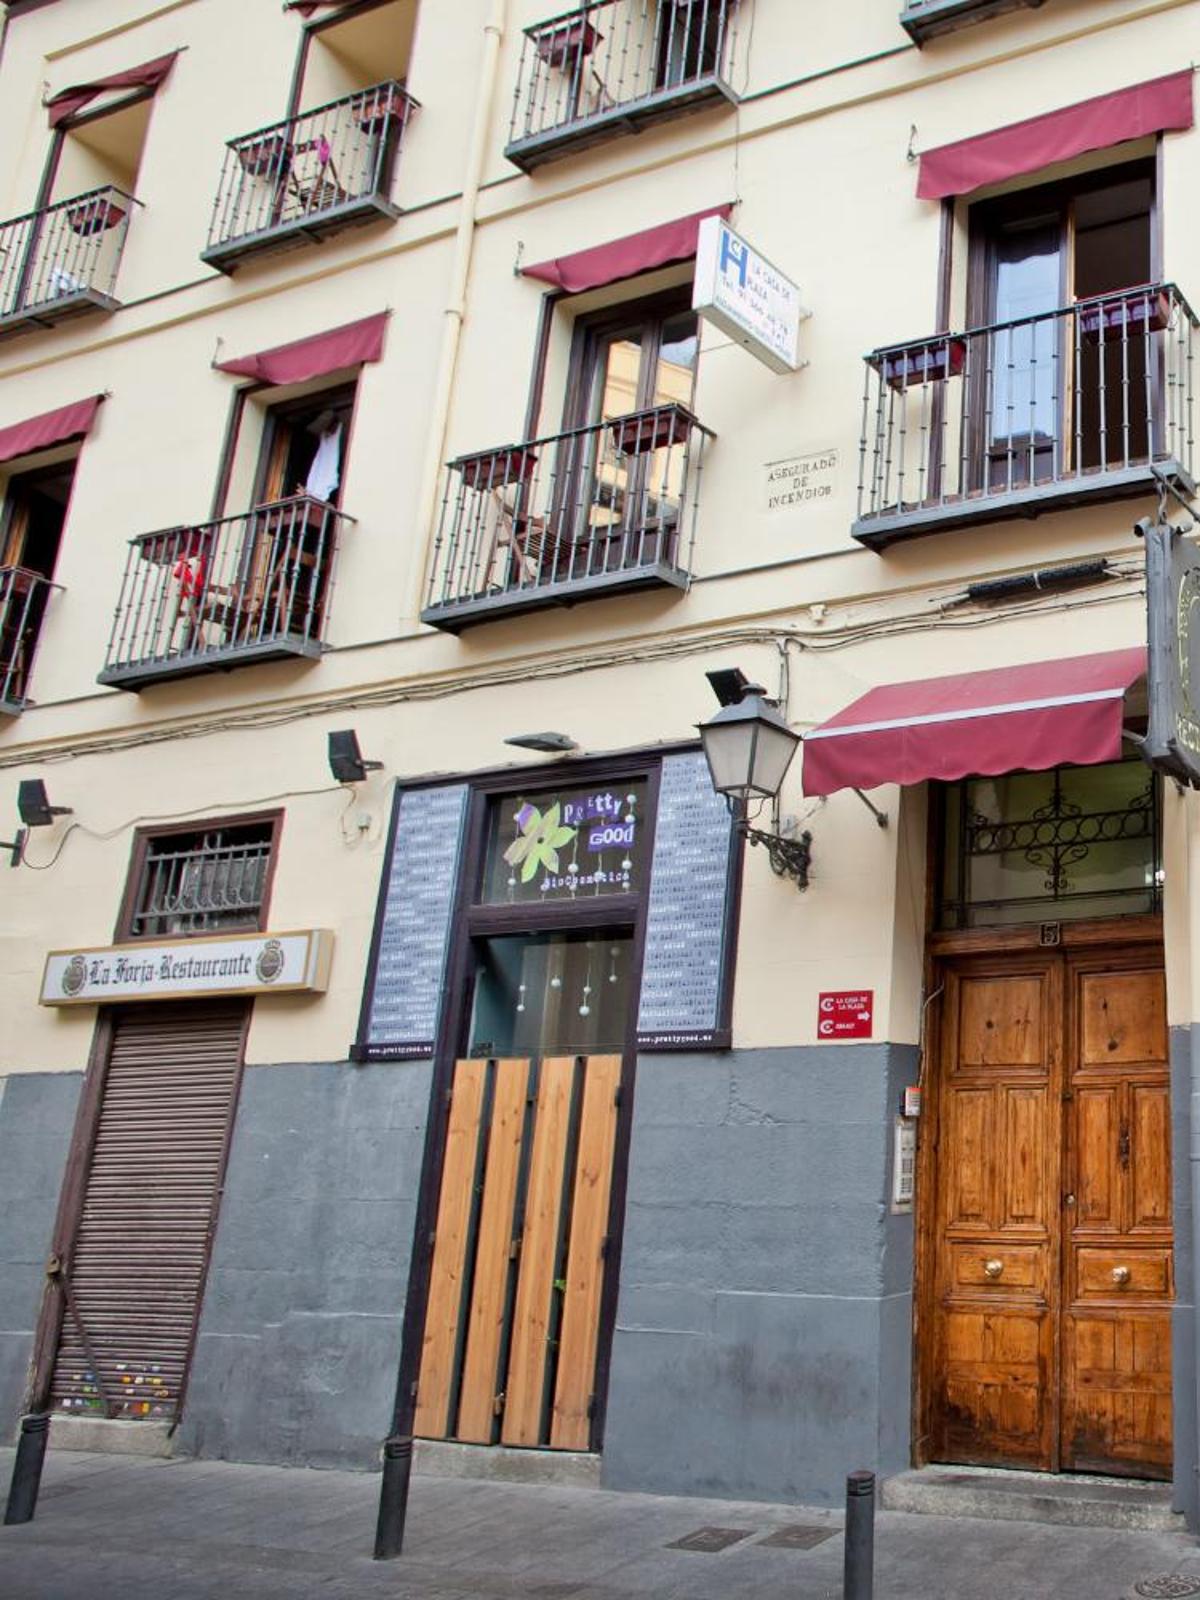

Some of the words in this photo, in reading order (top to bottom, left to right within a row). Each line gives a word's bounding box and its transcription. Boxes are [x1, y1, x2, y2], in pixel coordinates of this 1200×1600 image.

[768, 454, 836, 481] ASEGURADO
[793, 476, 808, 488] DE
[769, 486, 831, 508] INCENDIOS
[90, 959, 110, 985] La
